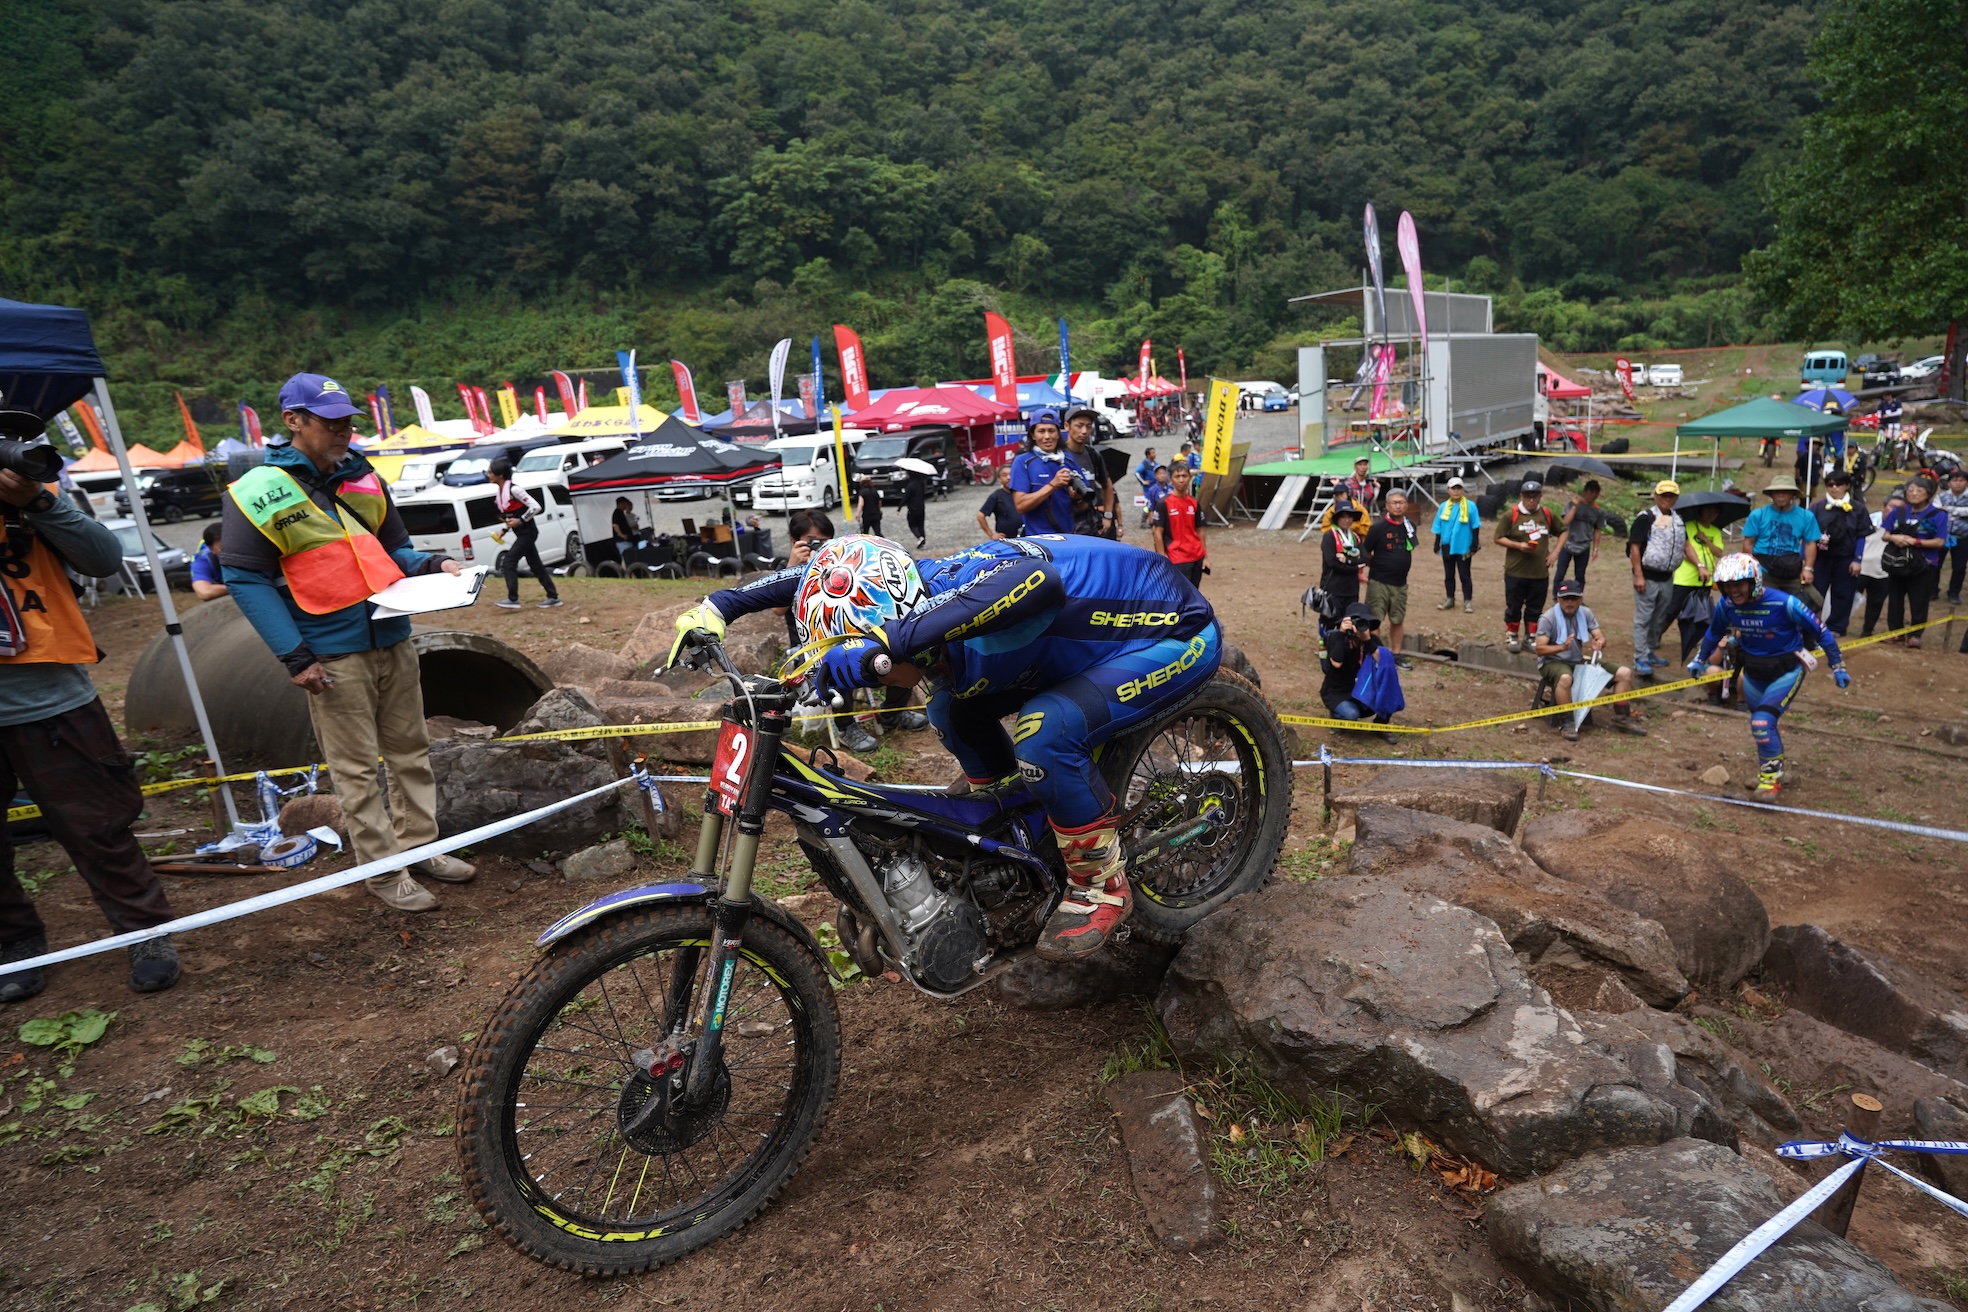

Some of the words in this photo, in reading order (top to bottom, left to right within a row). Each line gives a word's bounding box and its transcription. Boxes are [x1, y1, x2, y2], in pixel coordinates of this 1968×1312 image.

[1213, 402, 1227, 471] DUNLOP
[274, 509, 310, 531] OFFICIAL
[881, 554, 904, 598] Arai
[944, 570, 1046, 641] SHERCO
[1090, 611, 1180, 628] SHERCO
[1741, 619, 1764, 627] KENNY
[1116, 636, 1206, 703] SHERCO
[1156, 693, 1196, 720] MOTOR
[726, 732, 748, 785] 2
[1180, 825, 1204, 843] MOTOREX
[715, 962, 735, 1013] MOTOREX
